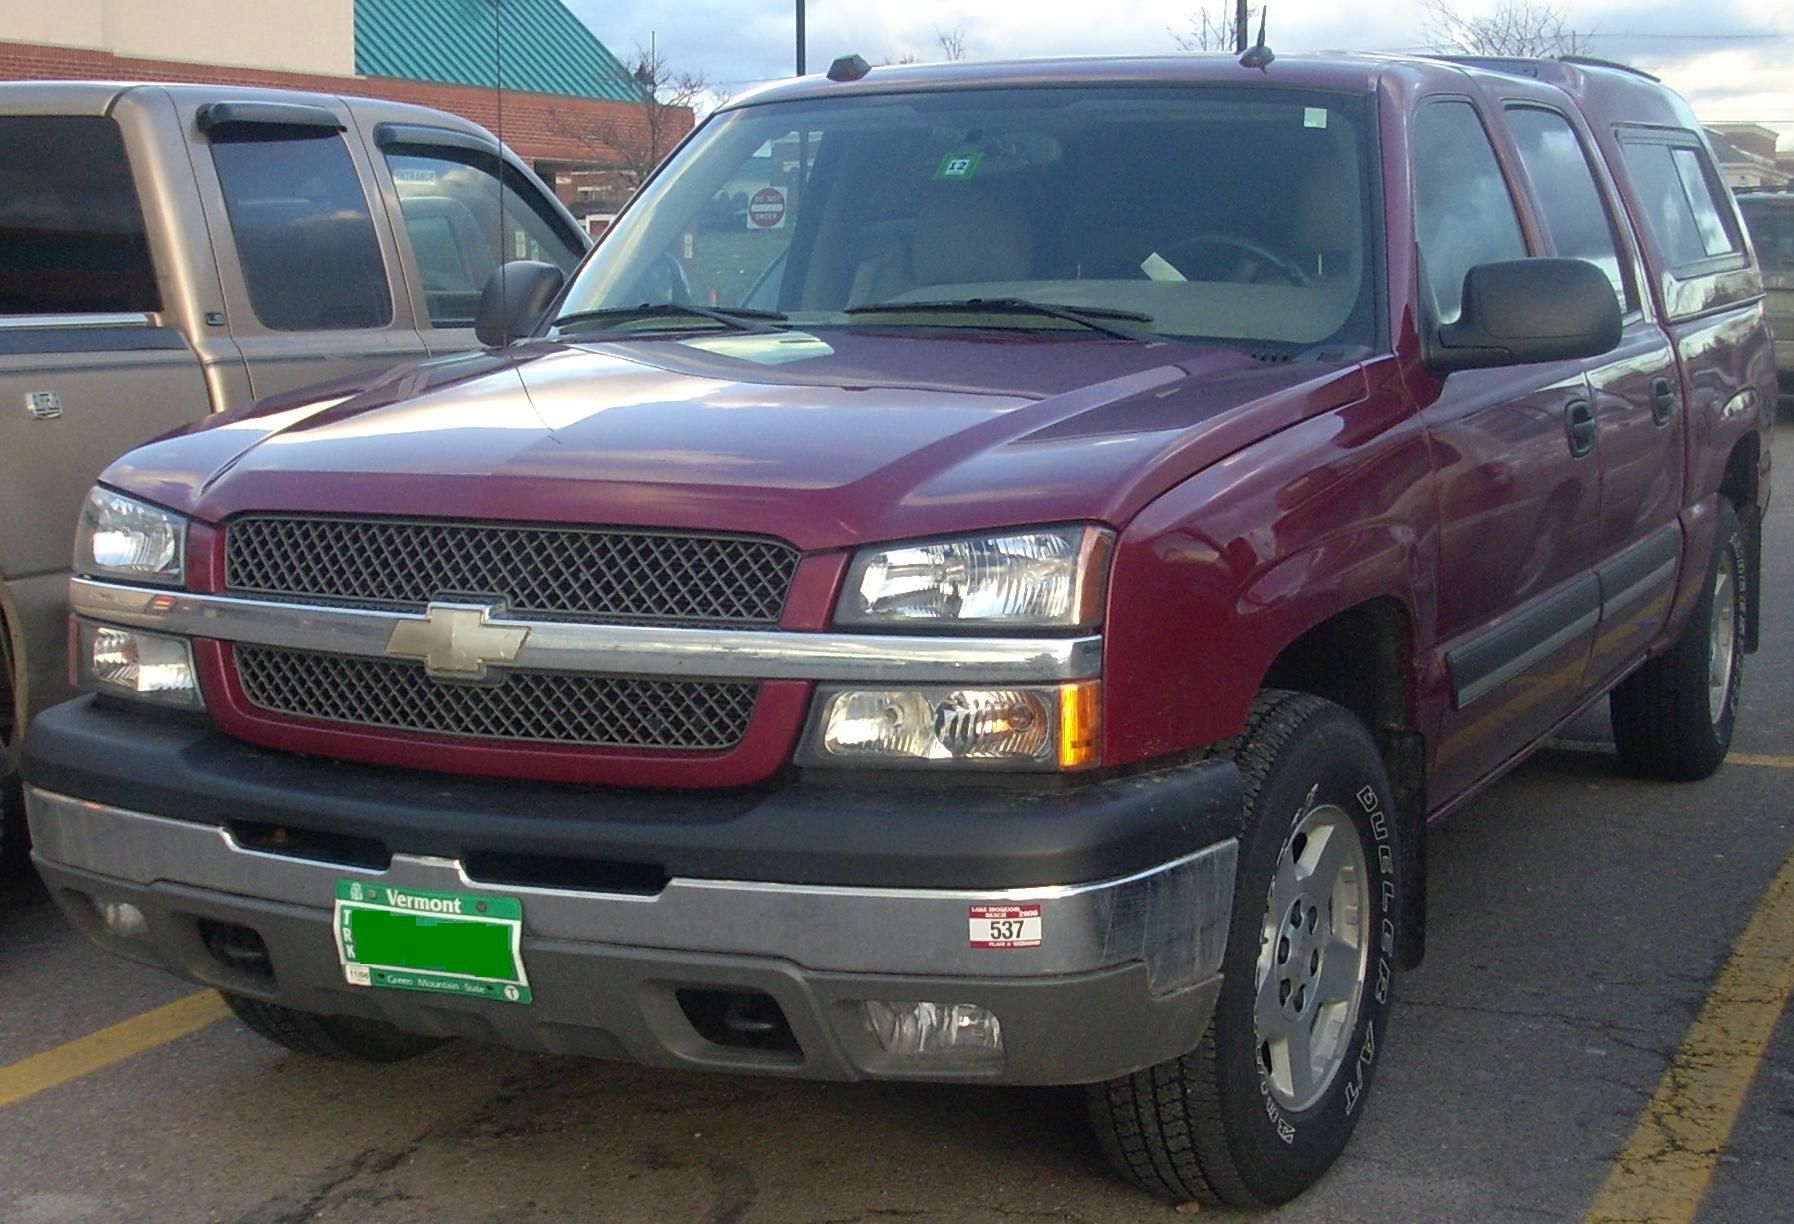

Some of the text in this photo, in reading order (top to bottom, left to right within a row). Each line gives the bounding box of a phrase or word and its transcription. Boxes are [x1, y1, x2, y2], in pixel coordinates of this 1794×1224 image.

[948, 161, 967, 170] 12
[386, 888, 462, 913] Vermont
[1357, 785, 1395, 1004] DUELER
[343, 909, 356, 959] TRK
[990, 920, 1025, 939] 537
[387, 974, 485, 994] Green Mountain State
